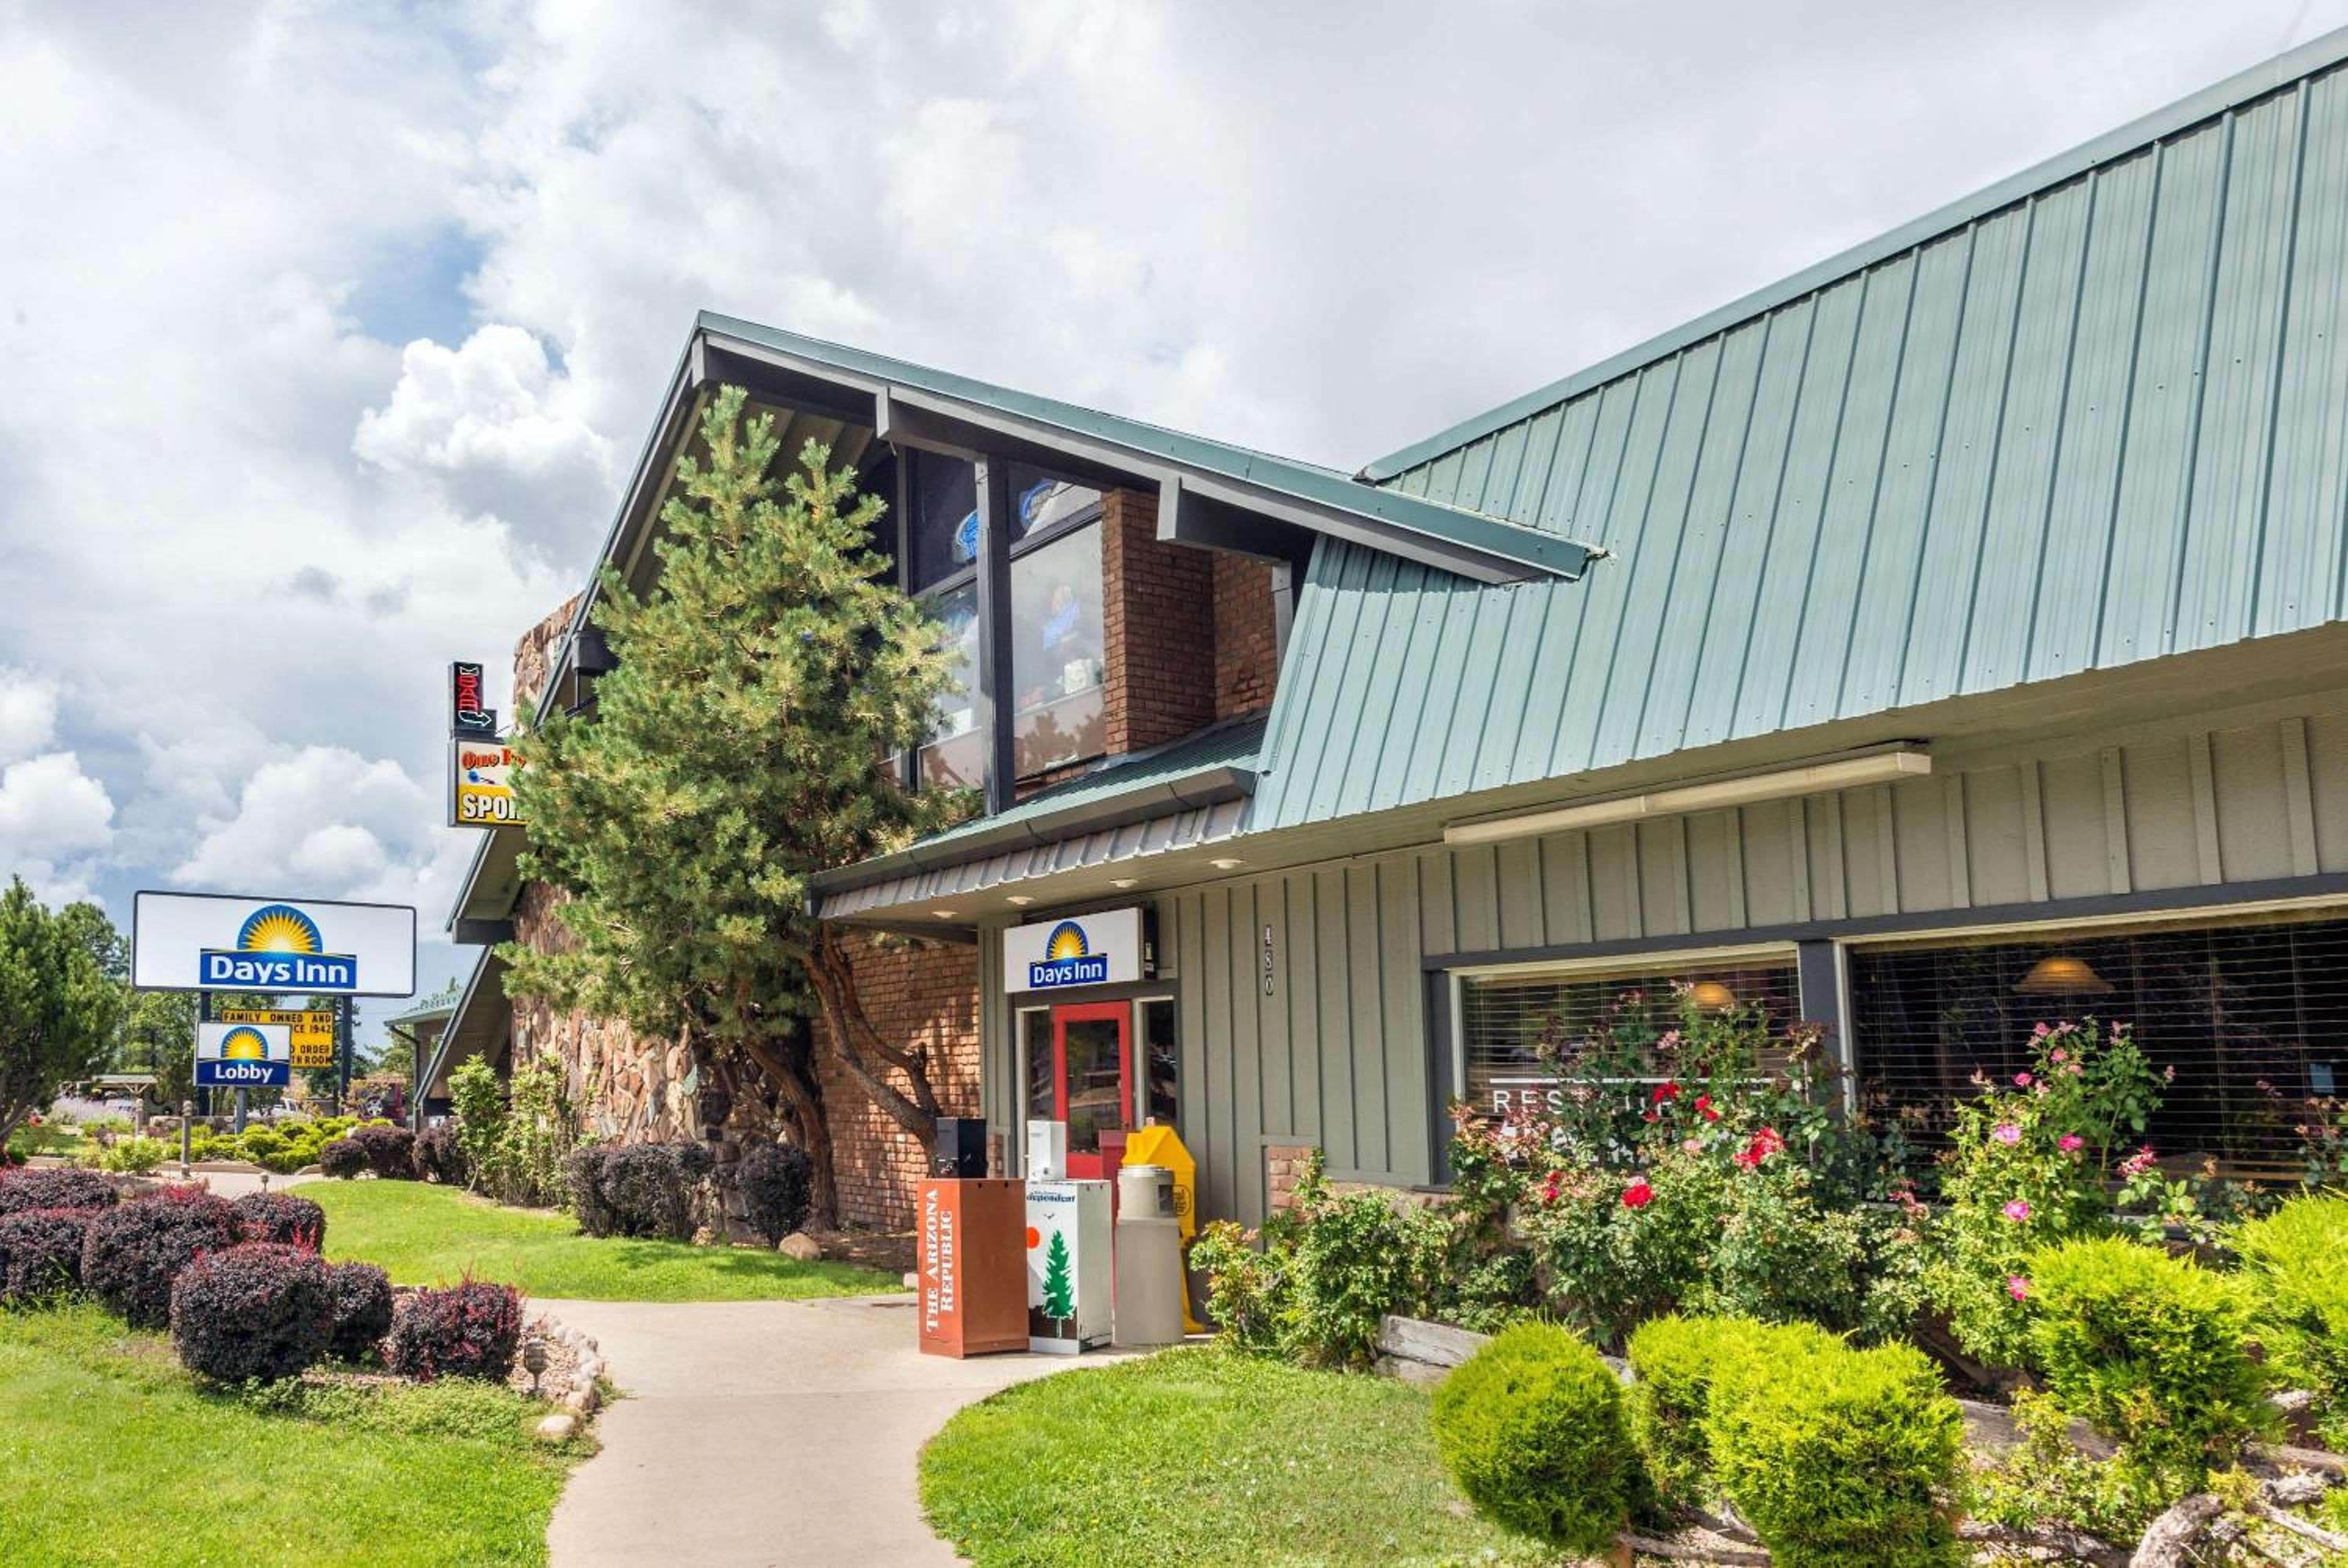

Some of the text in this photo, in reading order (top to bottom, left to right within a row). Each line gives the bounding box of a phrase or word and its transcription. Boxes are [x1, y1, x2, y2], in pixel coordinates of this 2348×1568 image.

[458, 675, 478, 710] BAR
[211, 955, 348, 984] Days Inn
[1034, 962, 1103, 984] Days Inn
[225, 1013, 331, 1023] FAMILY OWNED AND
[309, 1024, 331, 1034] 1942
[300, 1045, 330, 1054] ORDER
[291, 1056, 333, 1064] THROOM
[215, 1064, 273, 1083] Lobby
[926, 1189, 939, 1332] THE ARIZONA
[940, 1210, 953, 1312] REPUBLIC
